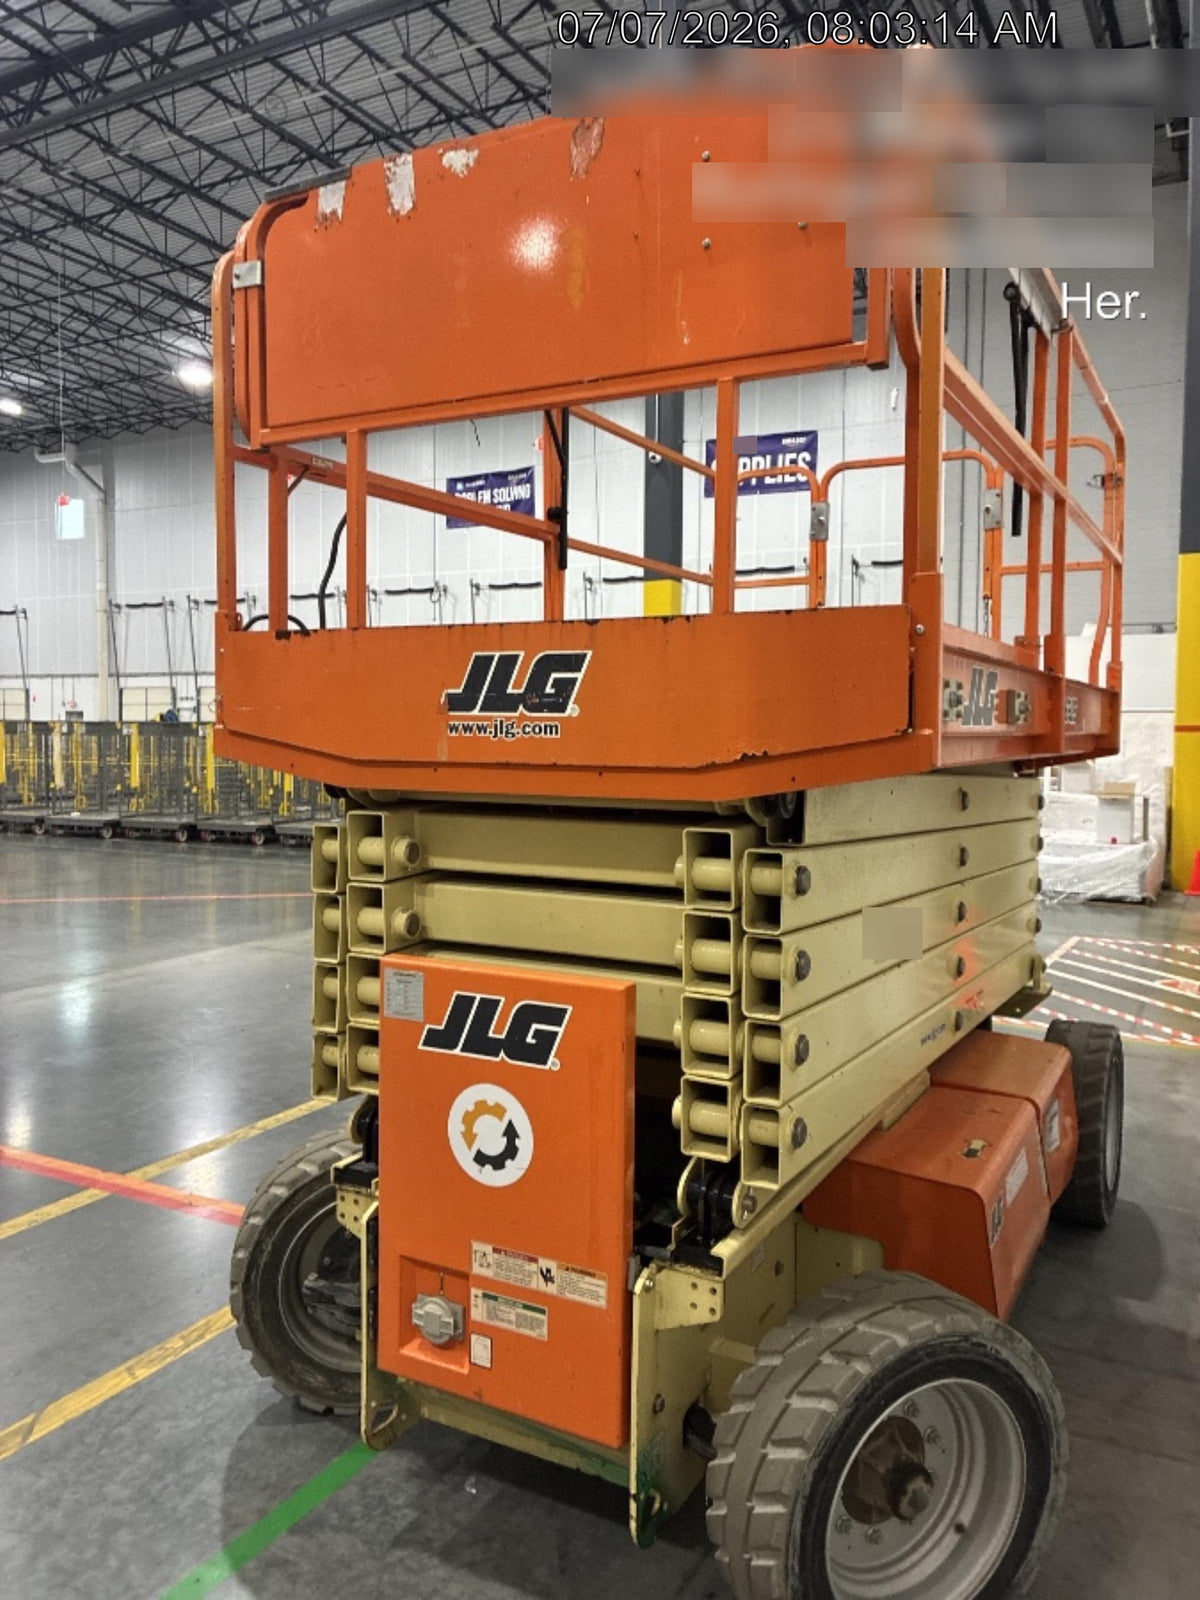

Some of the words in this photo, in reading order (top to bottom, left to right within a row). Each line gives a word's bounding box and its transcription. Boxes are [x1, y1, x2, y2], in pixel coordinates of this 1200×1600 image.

[442, 651, 592, 717] JLG
[448, 719, 560, 739] www.jlg.com
[418, 990, 573, 1069] JLG
